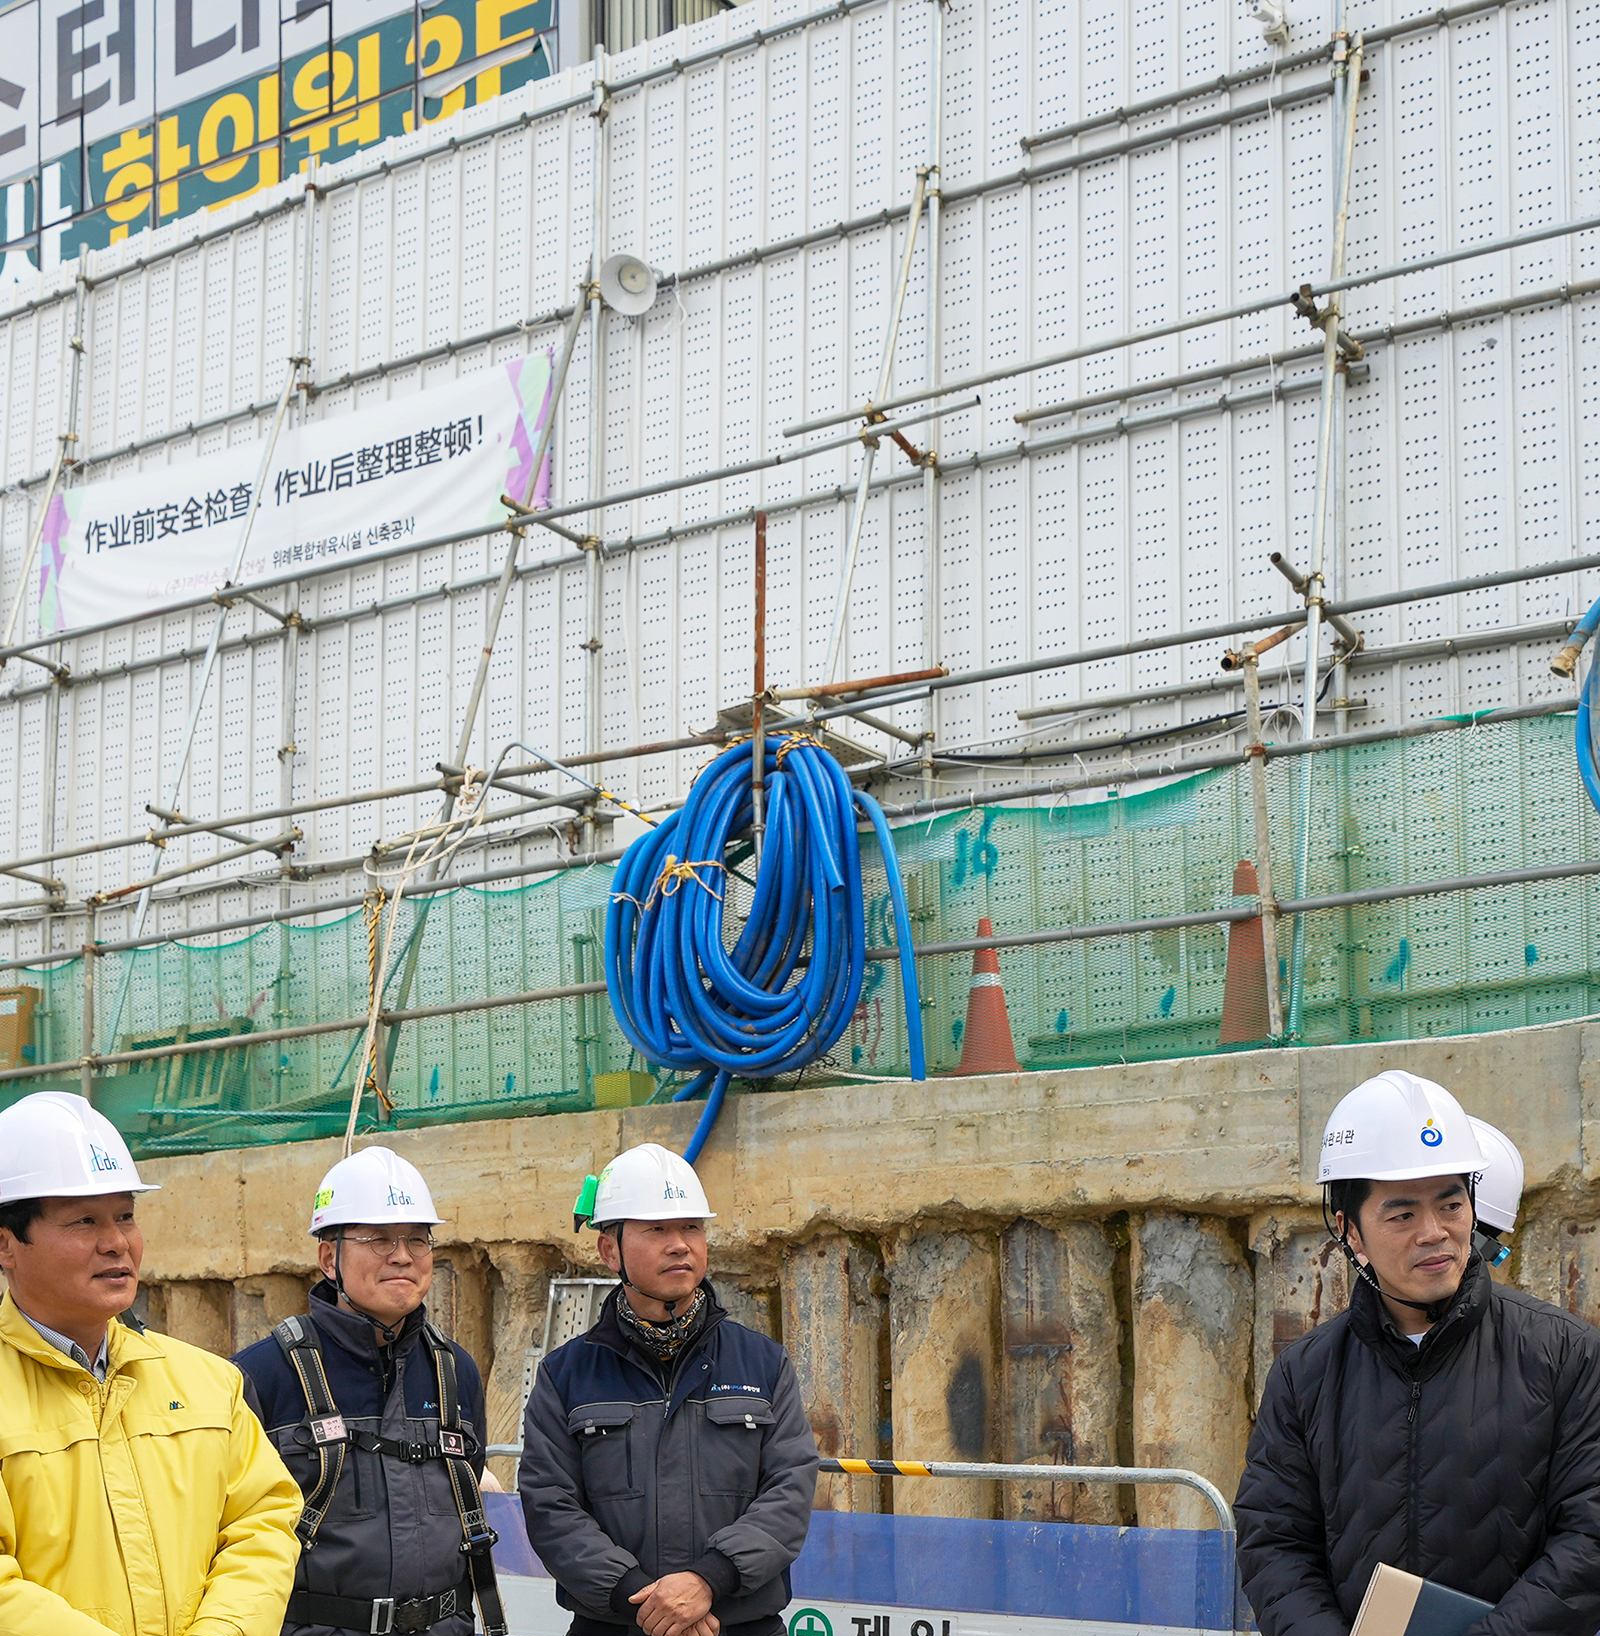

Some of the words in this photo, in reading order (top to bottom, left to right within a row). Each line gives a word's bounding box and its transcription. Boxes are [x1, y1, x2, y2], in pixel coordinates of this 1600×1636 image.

[275, 414, 484, 506] 作业后整理整顿!
[366, 516, 416, 547] 신축공사
[1321, 1130, 1355, 1148] 사관리관
